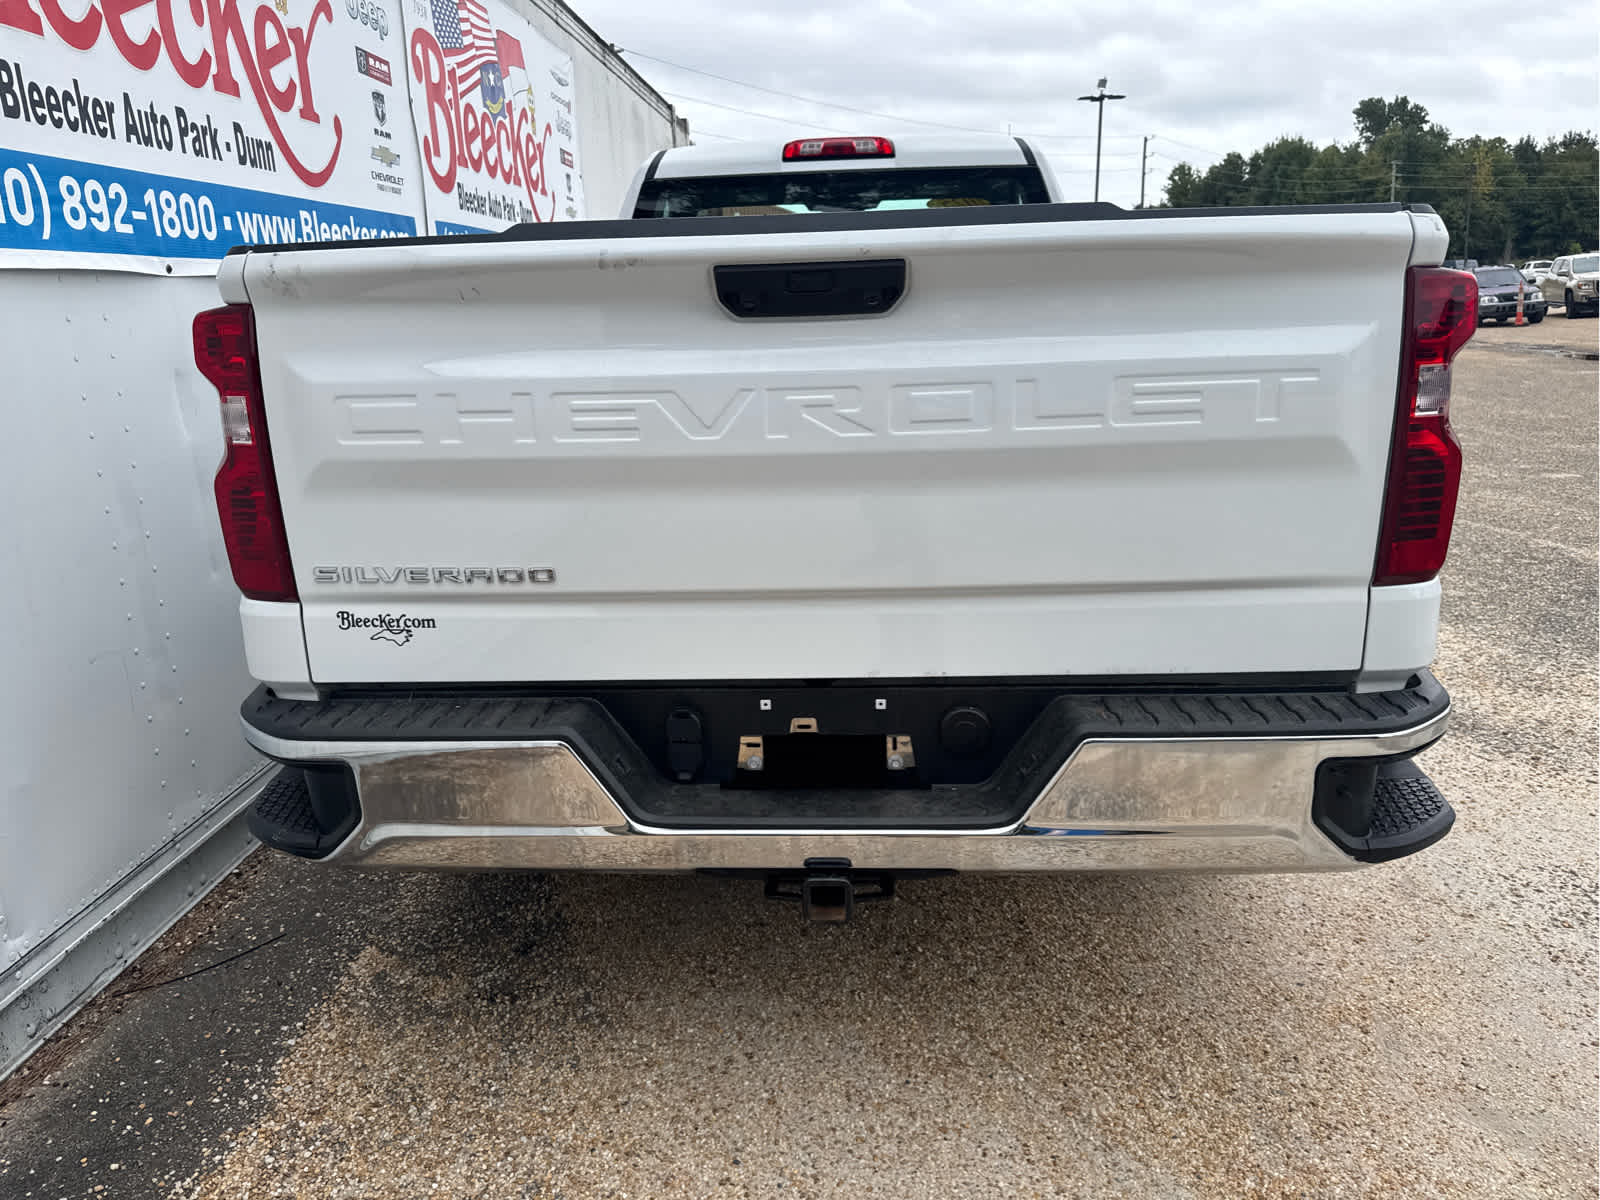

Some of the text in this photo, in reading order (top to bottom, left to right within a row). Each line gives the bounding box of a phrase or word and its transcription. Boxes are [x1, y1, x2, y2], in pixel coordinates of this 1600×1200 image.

[0, 59, 116, 140] Bleecker
[123, 92, 173, 151] Auto
[174, 106, 223, 161] Park
[232, 121, 276, 172] Dunn
[374, 128, 391, 140] RAM
[411, 28, 556, 222] Bleecker
[0, 163, 51, 240] 0)
[59, 175, 218, 241] 892-1800
[236, 210, 408, 243] www.Bleecker
[371, 170, 404, 185] CHEVROLET
[457, 182, 487, 216] Bleecker
[488, 191, 502, 220] Auto
[502, 195, 517, 223] Park
[335, 368, 1320, 445] CHEVROLET
[312, 566, 556, 584] SILVERADO
